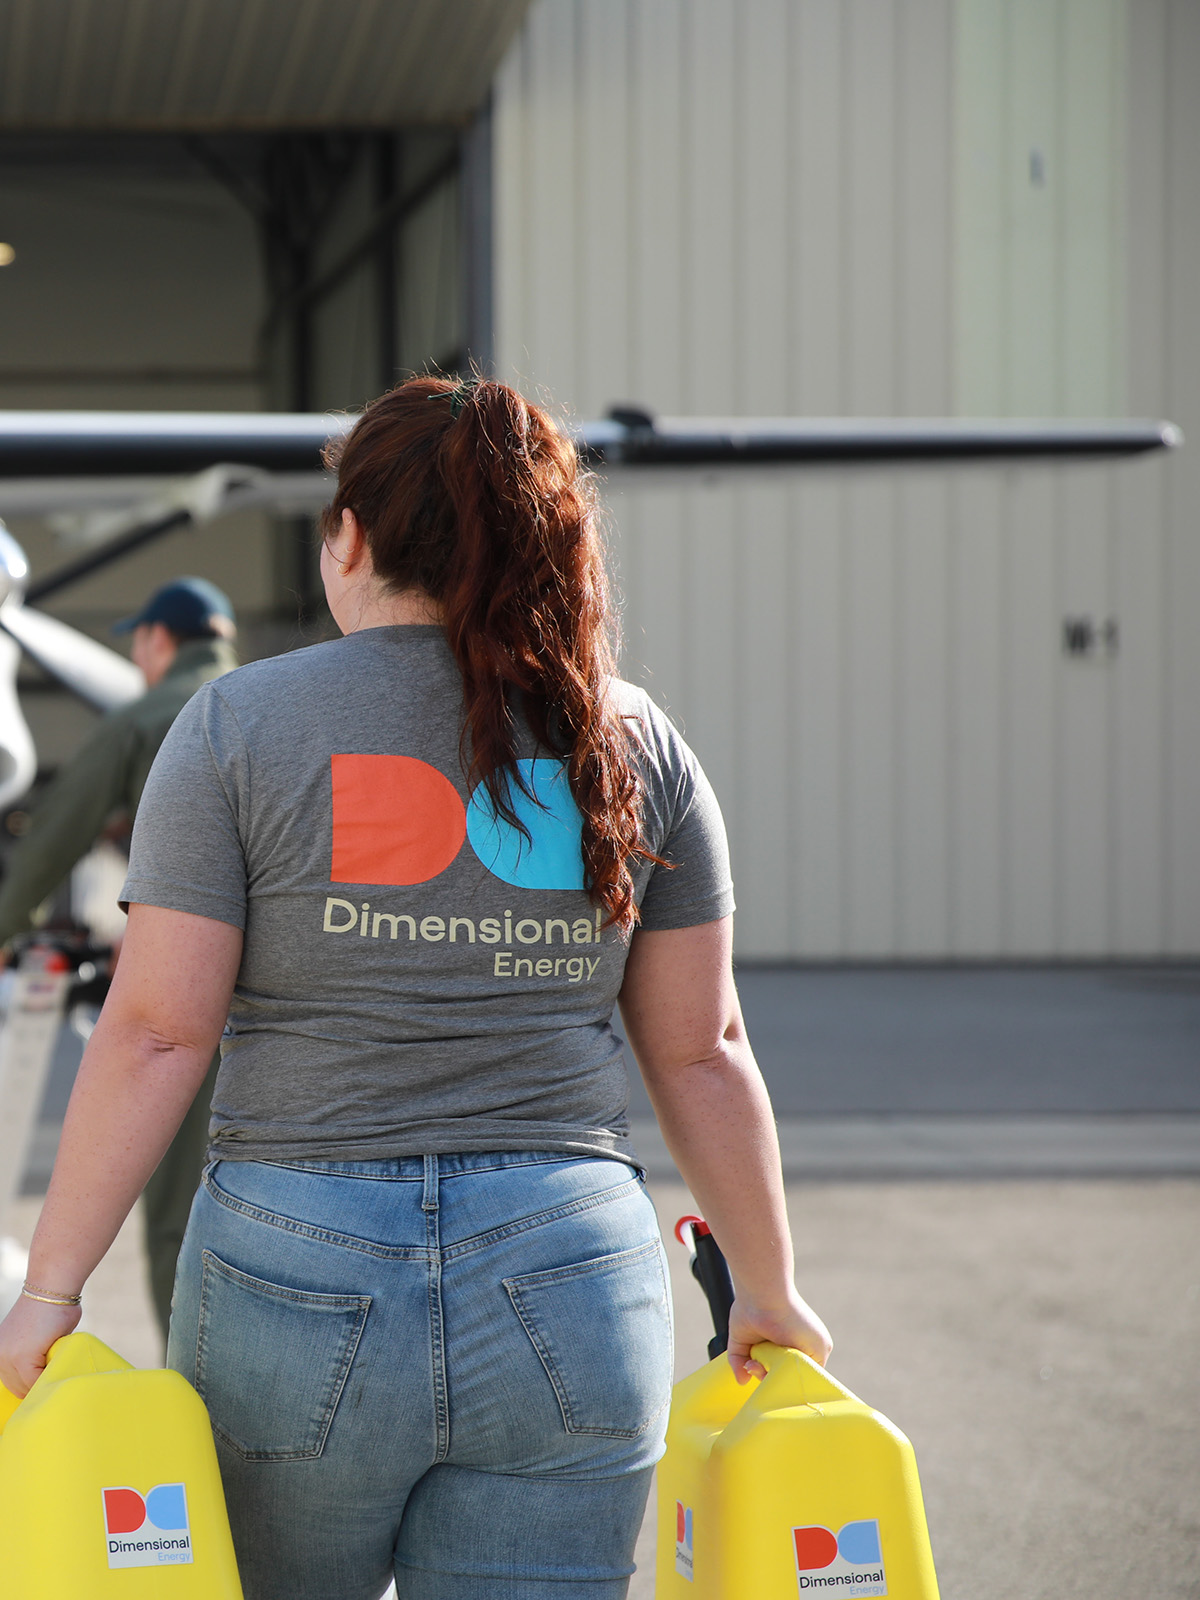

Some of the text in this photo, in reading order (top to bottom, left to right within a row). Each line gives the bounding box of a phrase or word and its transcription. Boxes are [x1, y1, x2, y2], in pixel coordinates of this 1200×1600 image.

[323, 897, 601, 944] Dimensional
[493, 952, 601, 982] Energy
[109, 1536, 190, 1553] Dimensional
[158, 1552, 191, 1562] Energy
[800, 1569, 884, 1589] Dimensional
[849, 1586, 885, 1595] Energy
